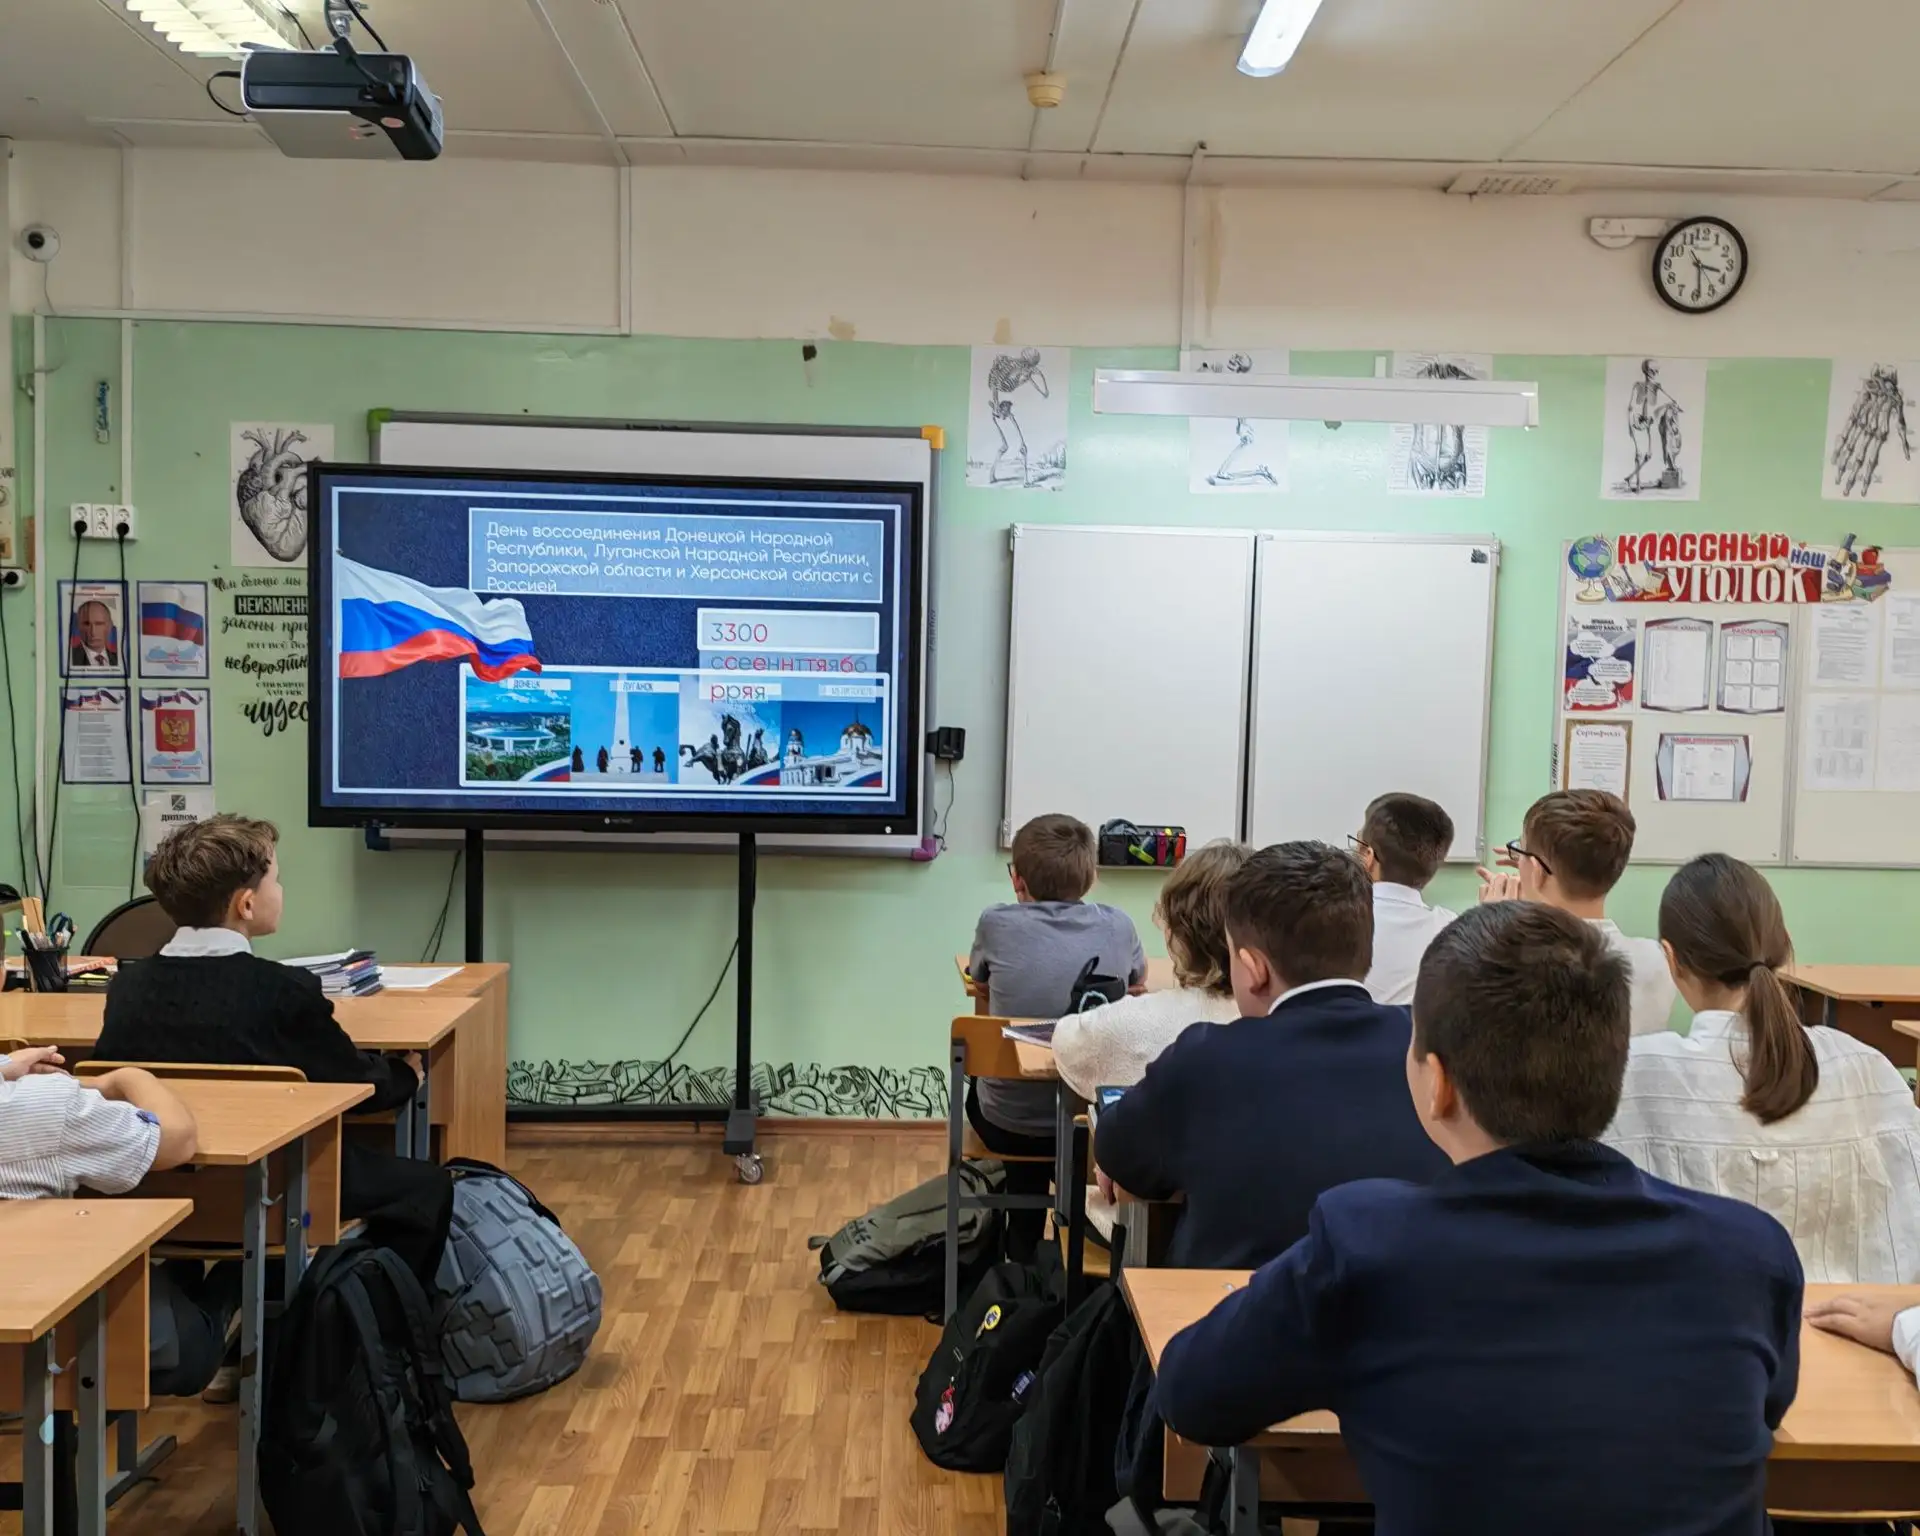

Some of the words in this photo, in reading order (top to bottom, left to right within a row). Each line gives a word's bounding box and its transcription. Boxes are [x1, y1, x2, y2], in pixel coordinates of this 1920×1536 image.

[1682, 232, 1695, 245] 11
[1695, 228, 1711, 241] 12
[1714, 233, 1720, 246] 1
[1670, 244, 1685, 258] 10
[1721, 245, 1730, 258] 2
[1663, 258, 1673, 271] 9
[1726, 259, 1735, 272] 3
[1666, 272, 1677, 285] 8
[1718, 272, 1727, 285] 4
[1677, 284, 1686, 297] 7
[1691, 289, 1701, 302] 6
[486, 521, 528, 538] День
[532, 526, 661, 541] воссоединения
[664, 527, 746, 545] Донецкой
[750, 530, 833, 548] Народной
[486, 540, 588, 560] Республики,
[594, 543, 680, 561] Луганской
[685, 547, 768, 564] Народной
[773, 549, 870, 567] Республики,
[1617, 532, 1790, 565] КЛАССНЫЙ
[1790, 548, 1827, 569] НАШ
[486, 558, 599, 577] Запорожской
[603, 563, 672, 577] области
[676, 566, 686, 578] и
[690, 565, 788, 582] Херсонской
[792, 568, 859, 584] области
[863, 572, 874, 584] с
[486, 576, 557, 593] Россией
[1660, 563, 1809, 604] УГОЛОК
[221, 615, 275, 635] законы
[711, 622, 769, 643] 3300
[160, 813, 199, 823] ДИПЛОМ
